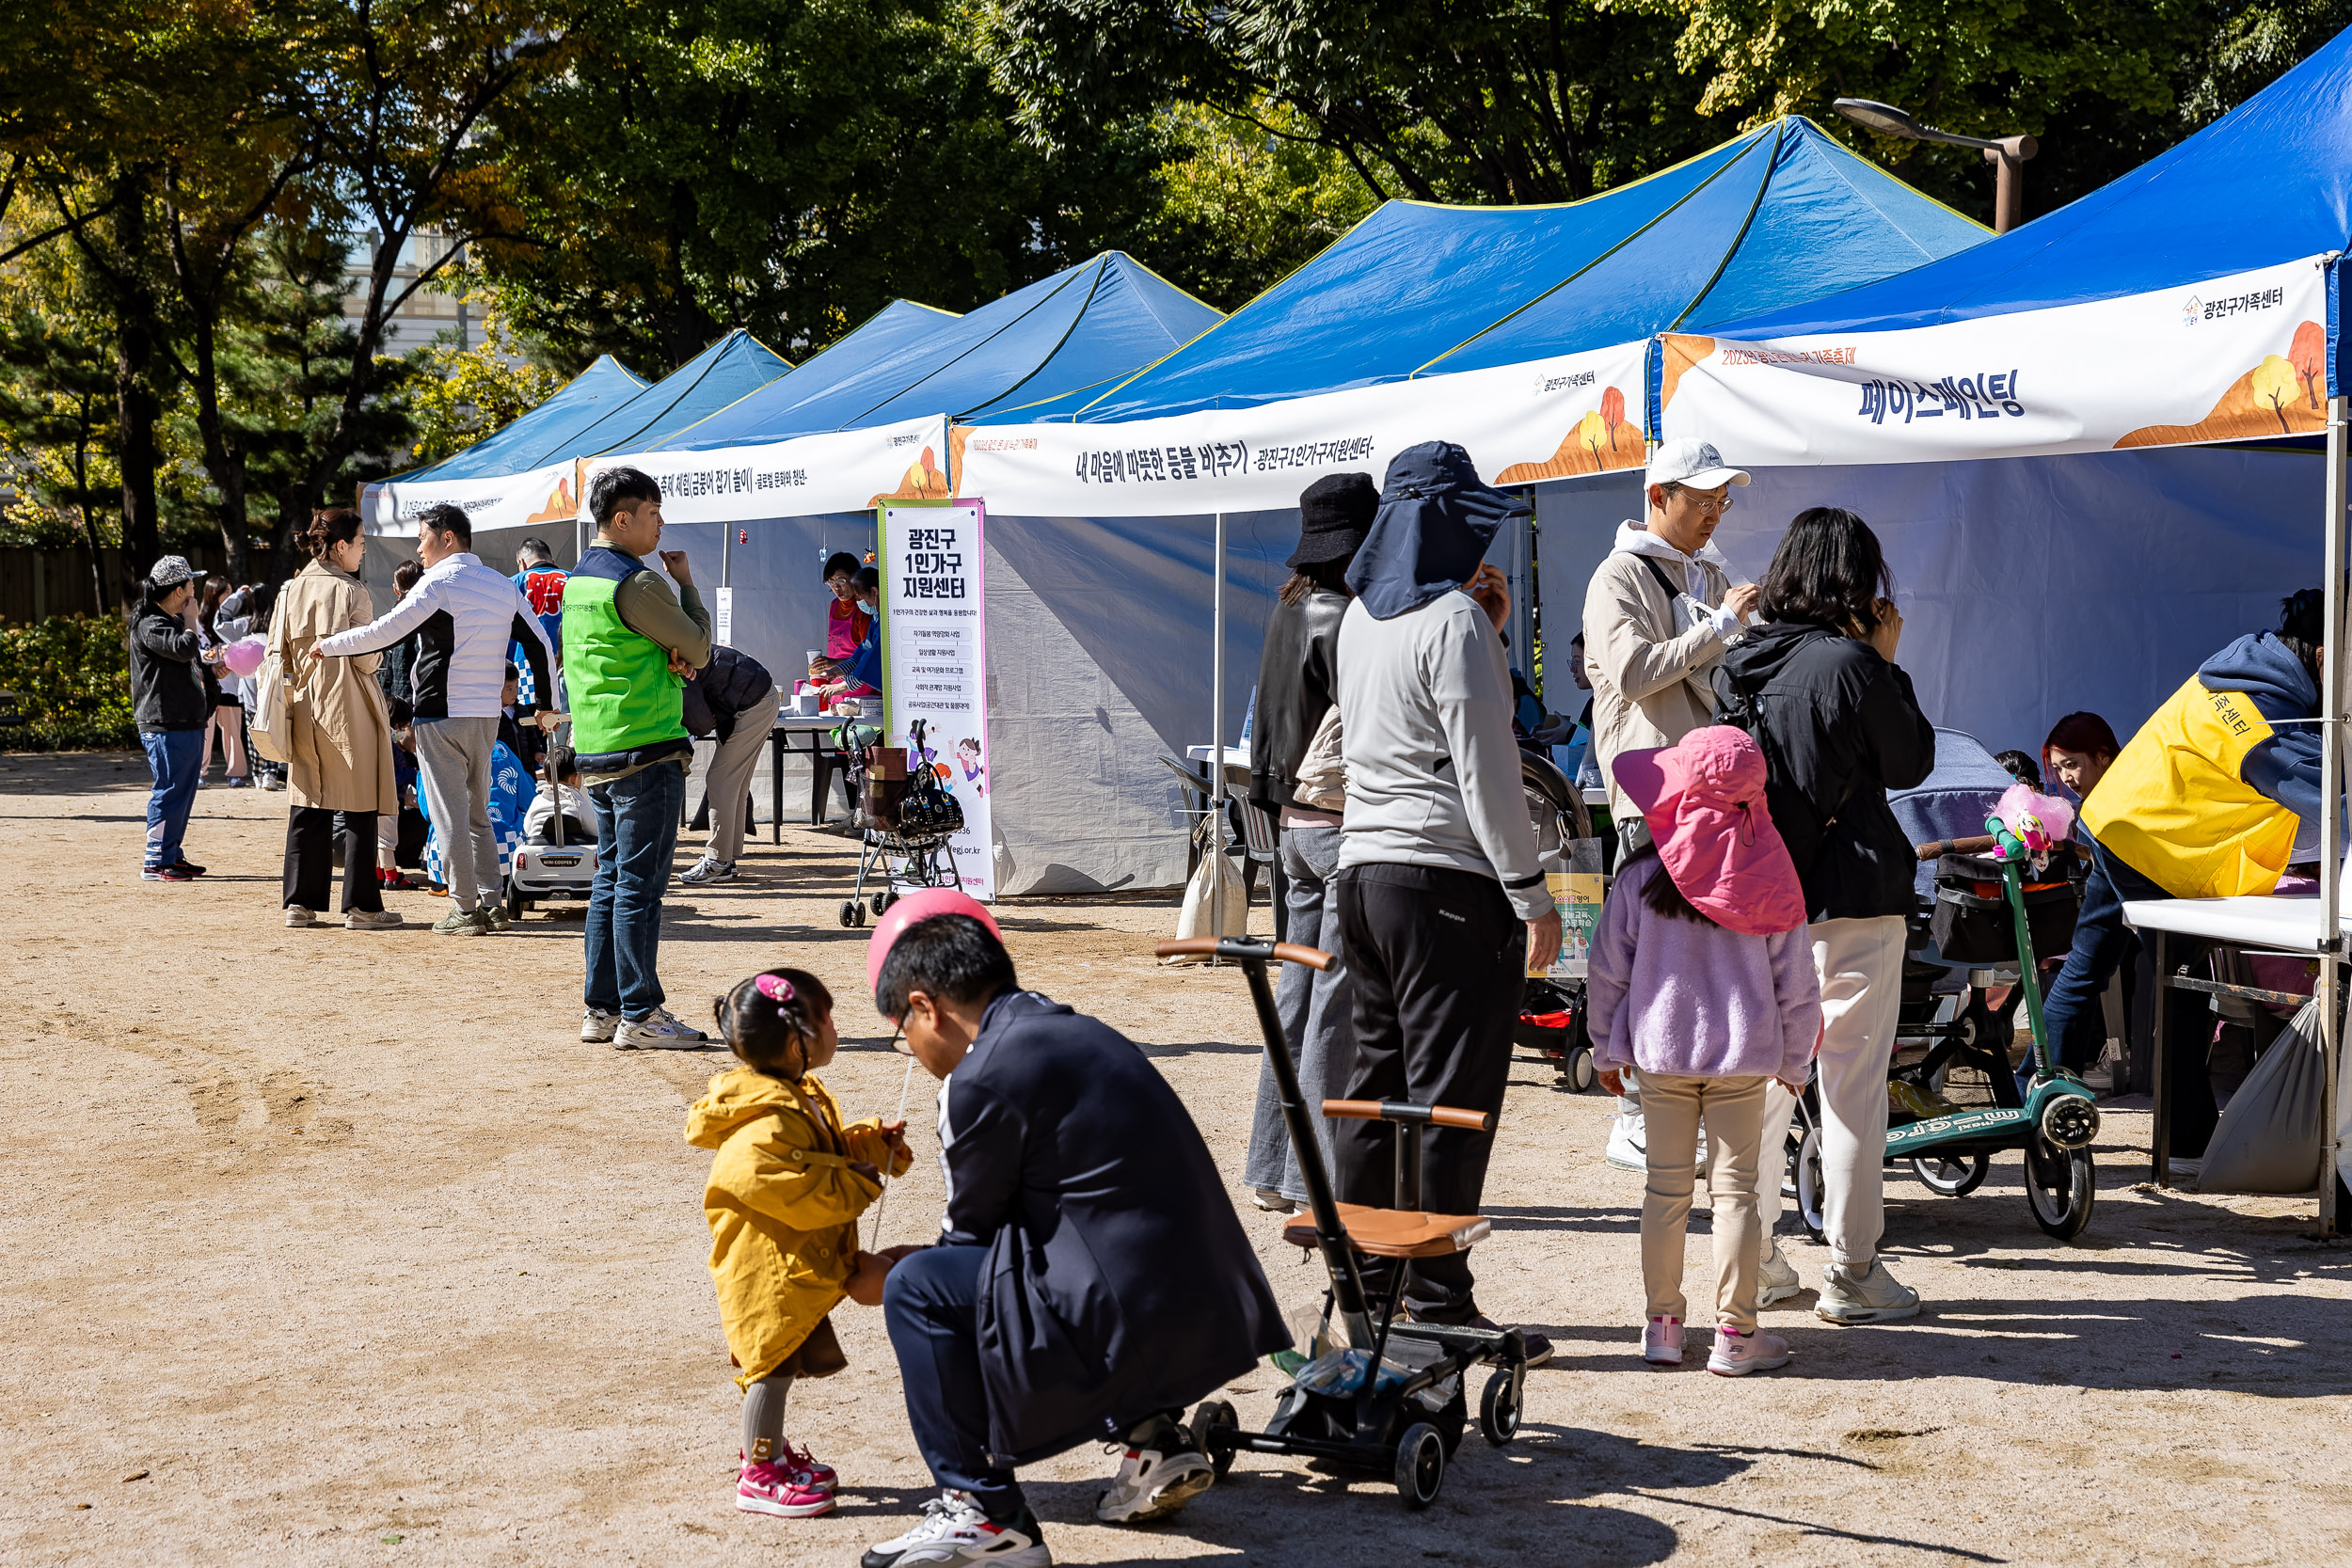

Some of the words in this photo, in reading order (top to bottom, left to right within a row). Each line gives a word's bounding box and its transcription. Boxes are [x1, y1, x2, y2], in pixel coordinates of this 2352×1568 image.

[2203, 286, 2283, 320] 광진구가족센터
[1722, 349, 1758, 365] 2023년
[1812, 346, 1857, 365] 가족축제
[1544, 370, 1596, 392] 광진구가족센터
[1858, 369, 2026, 424] 페이스페인팅
[1075, 451, 1089, 483] 내
[1090, 450, 1126, 483] 마음에
[1126, 447, 1167, 483] 따뜻한
[1167, 446, 1199, 481] 등불
[1198, 439, 1248, 478] 비추기
[1253, 436, 1375, 472] -광진구1인가구지원센터-
[660, 473, 675, 499] 축제
[715, 467, 732, 494] 잡기
[774, 469, 792, 488] 문화와
[908, 529, 956, 550] 광진구
[905, 552, 962, 575] 1인가구
[903, 578, 964, 600] 지원센터
[950, 630, 961, 639] 사업
[921, 666, 927, 674] 및
[943, 684, 961, 692] 지원사업
[1576, 895, 1590, 904] 영어
[1438, 909, 1466, 923] Kappa
[1916, 1116, 1952, 1127] maxi
[1958, 1120, 1994, 1132] maxi
